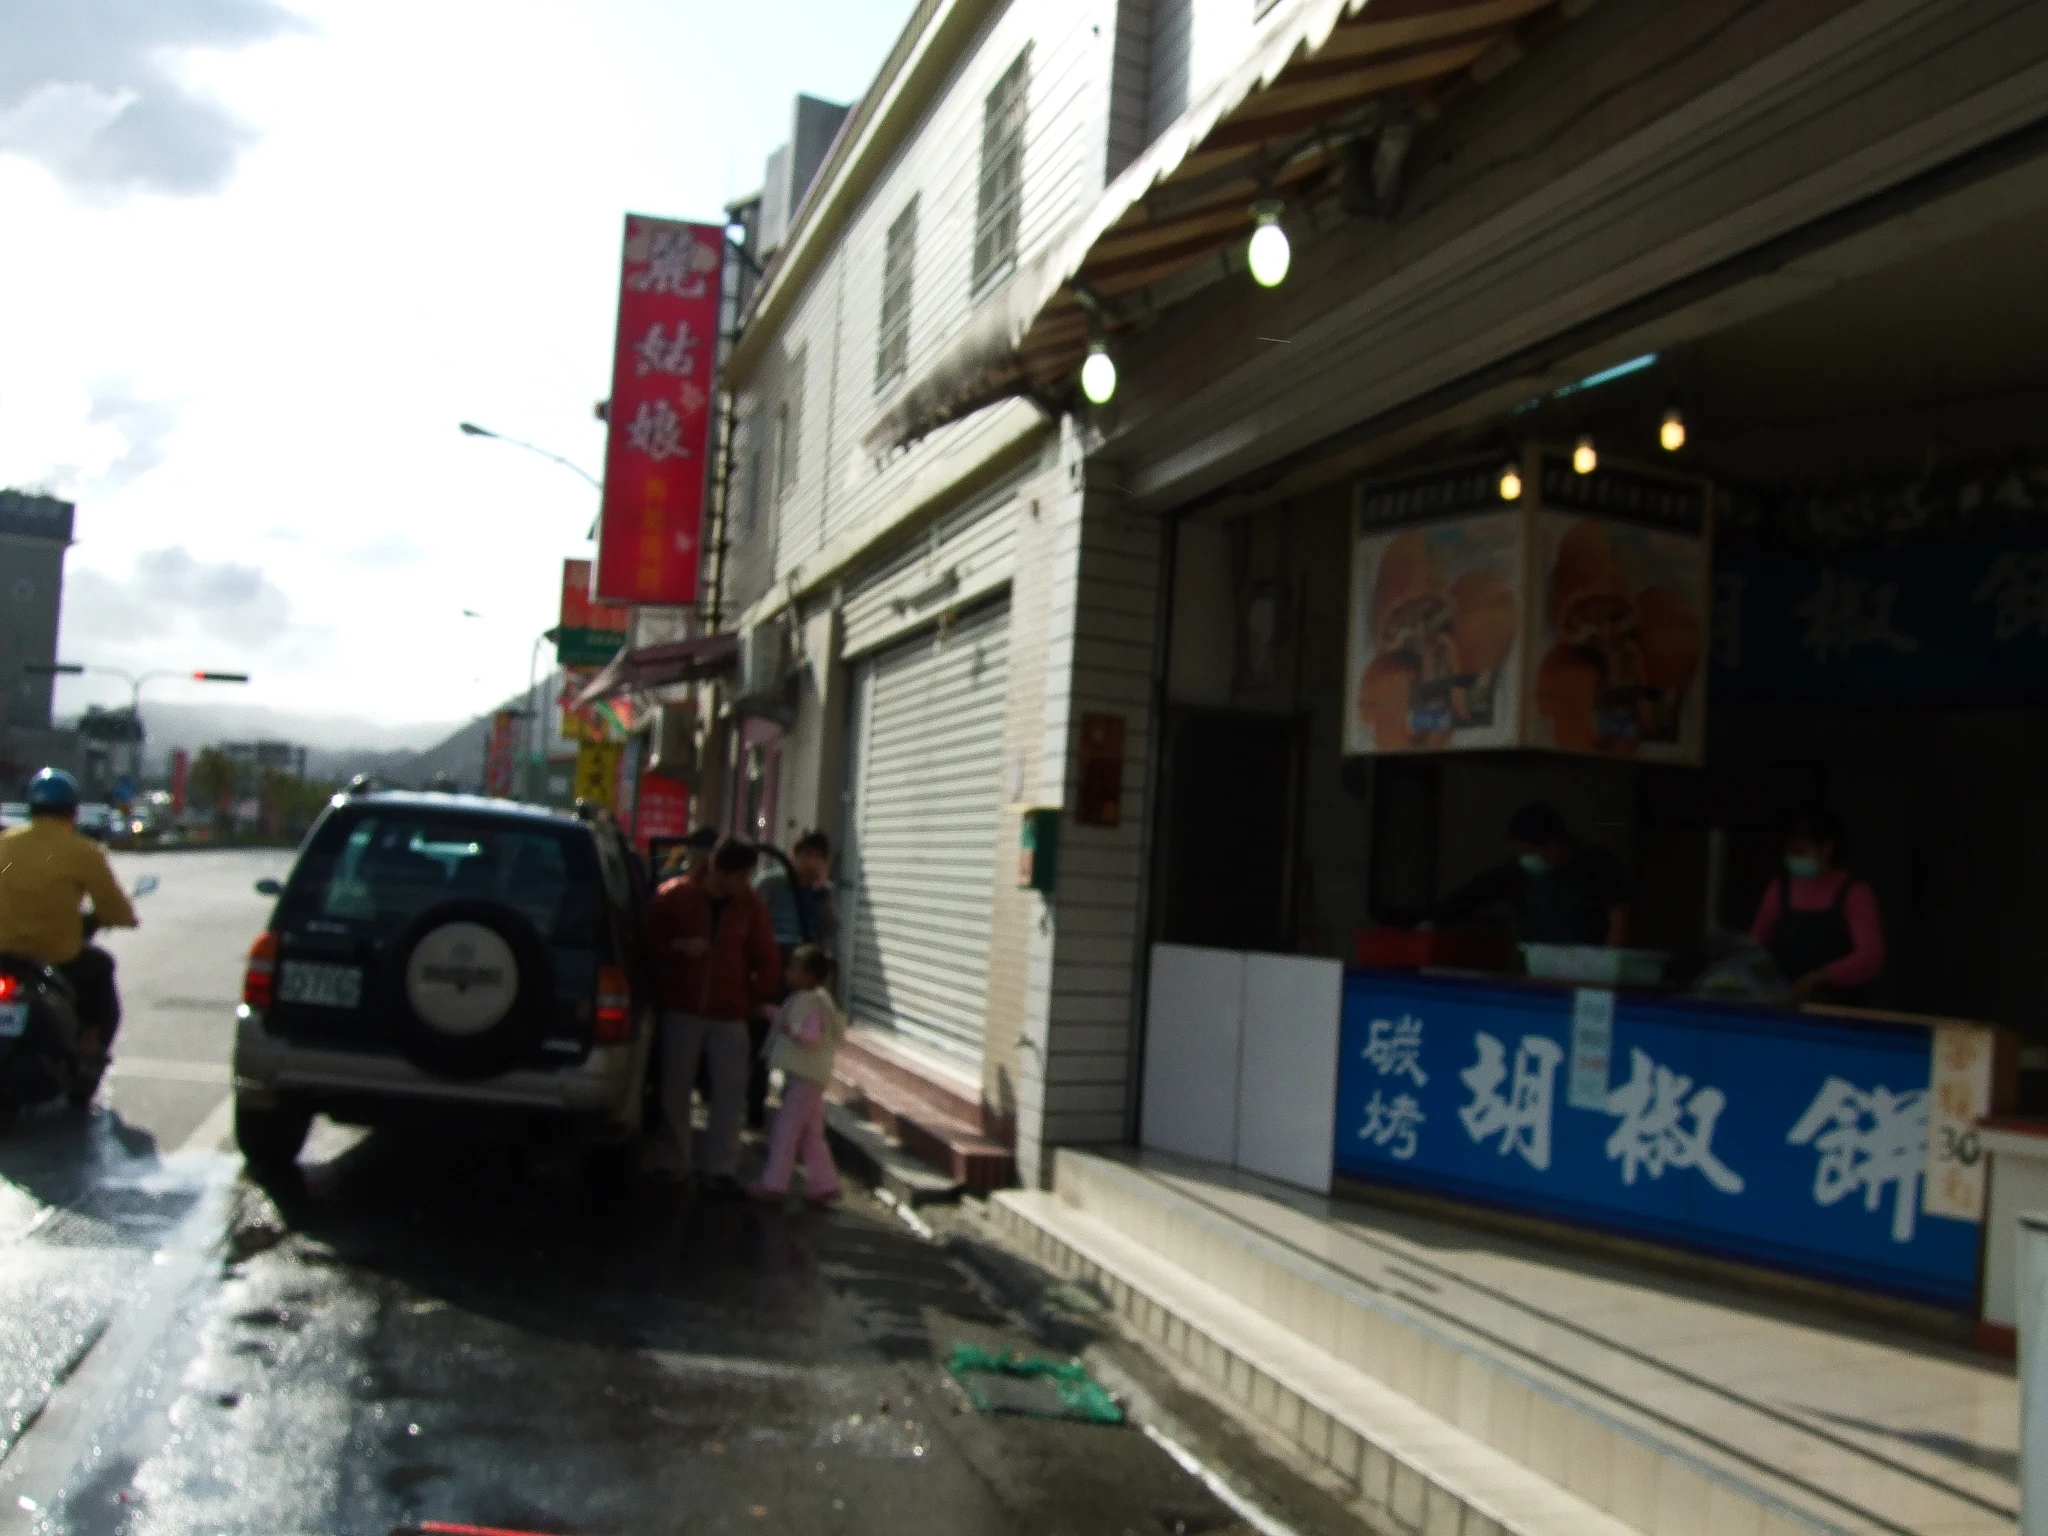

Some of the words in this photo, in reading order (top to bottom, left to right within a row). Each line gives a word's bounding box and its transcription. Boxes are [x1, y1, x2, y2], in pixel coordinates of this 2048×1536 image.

[1359, 1014, 1428, 1160] 碳烤
[1458, 1030, 1932, 1244] 胡椒餅
[1939, 1126, 1981, 1166] 30
